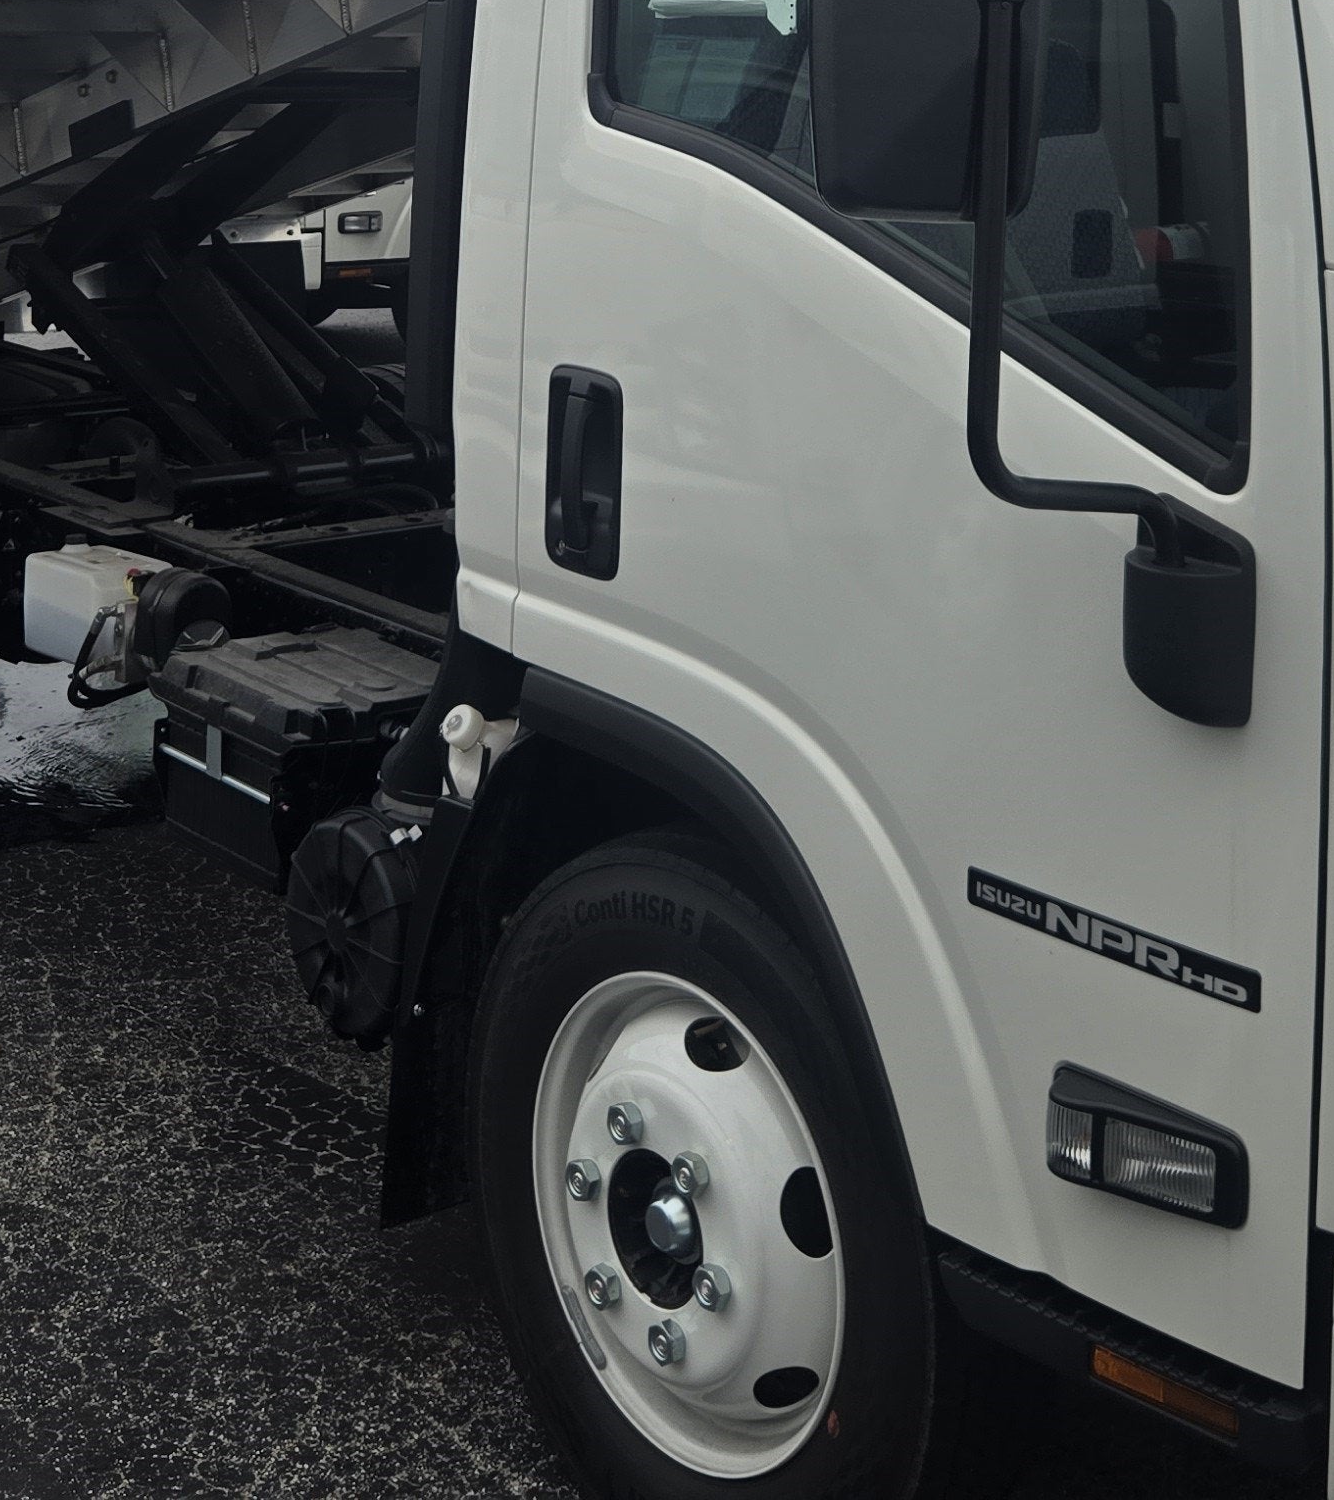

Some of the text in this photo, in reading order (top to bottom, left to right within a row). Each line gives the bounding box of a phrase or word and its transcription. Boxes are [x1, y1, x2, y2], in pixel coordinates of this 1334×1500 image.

[573, 890, 695, 936] Conti HSR 5
[975, 880, 1248, 1003] ISUZU NPR HD
